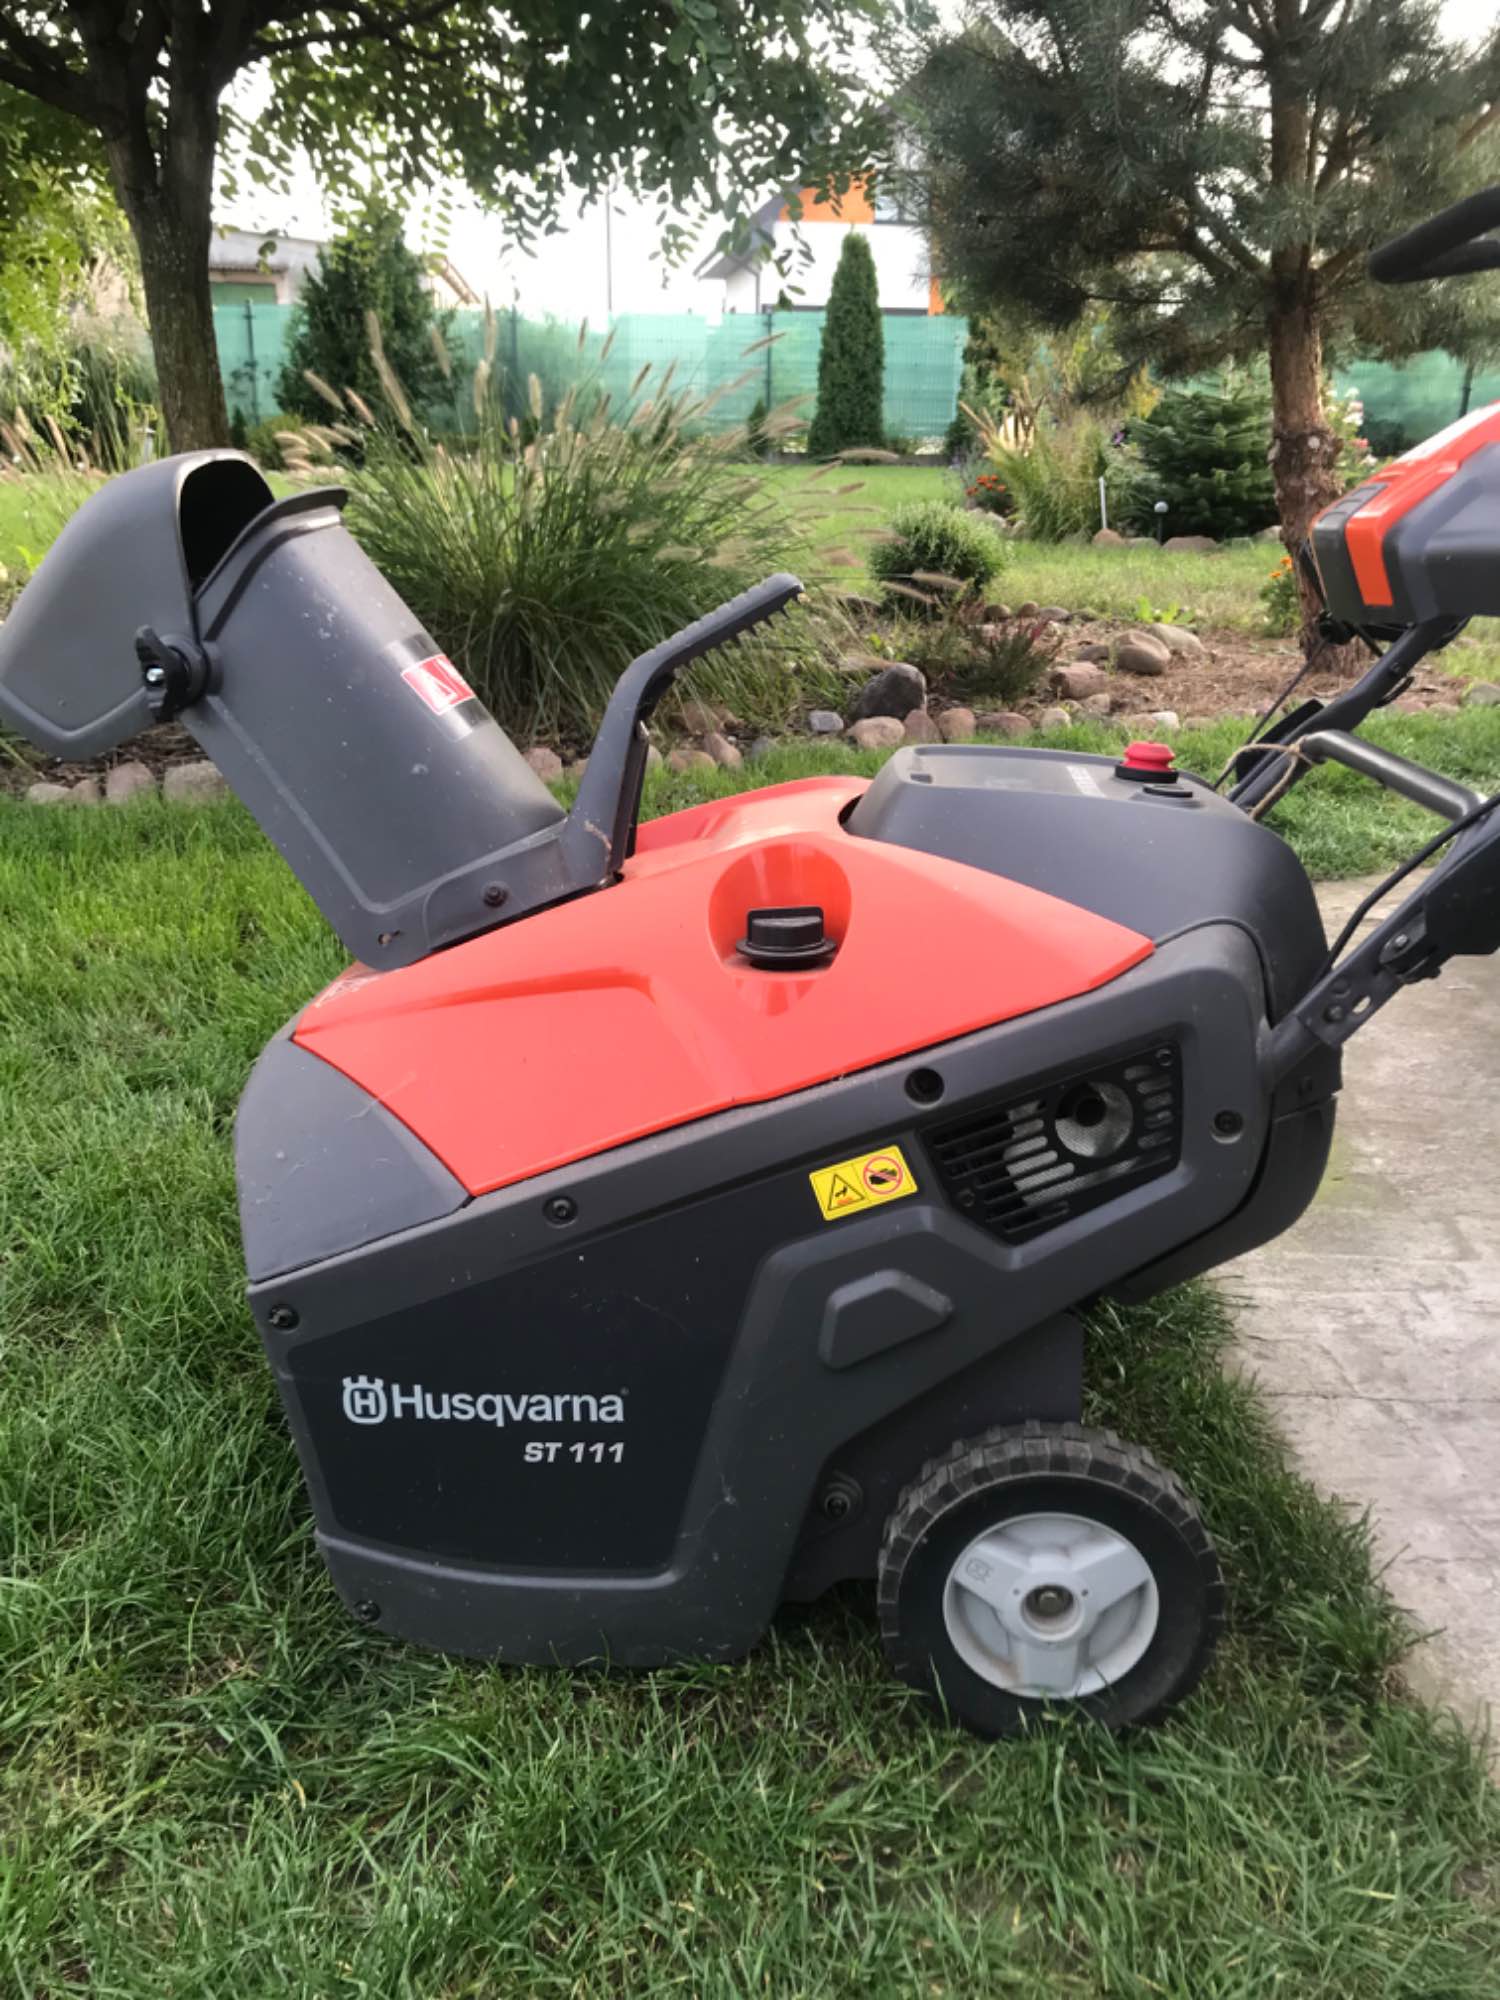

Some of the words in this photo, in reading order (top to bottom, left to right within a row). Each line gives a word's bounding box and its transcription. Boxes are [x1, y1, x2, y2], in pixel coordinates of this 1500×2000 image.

[391, 1383, 625, 1427] Husqvarna
[523, 1441, 563, 1463] ST
[569, 1441, 625, 1463] 111
